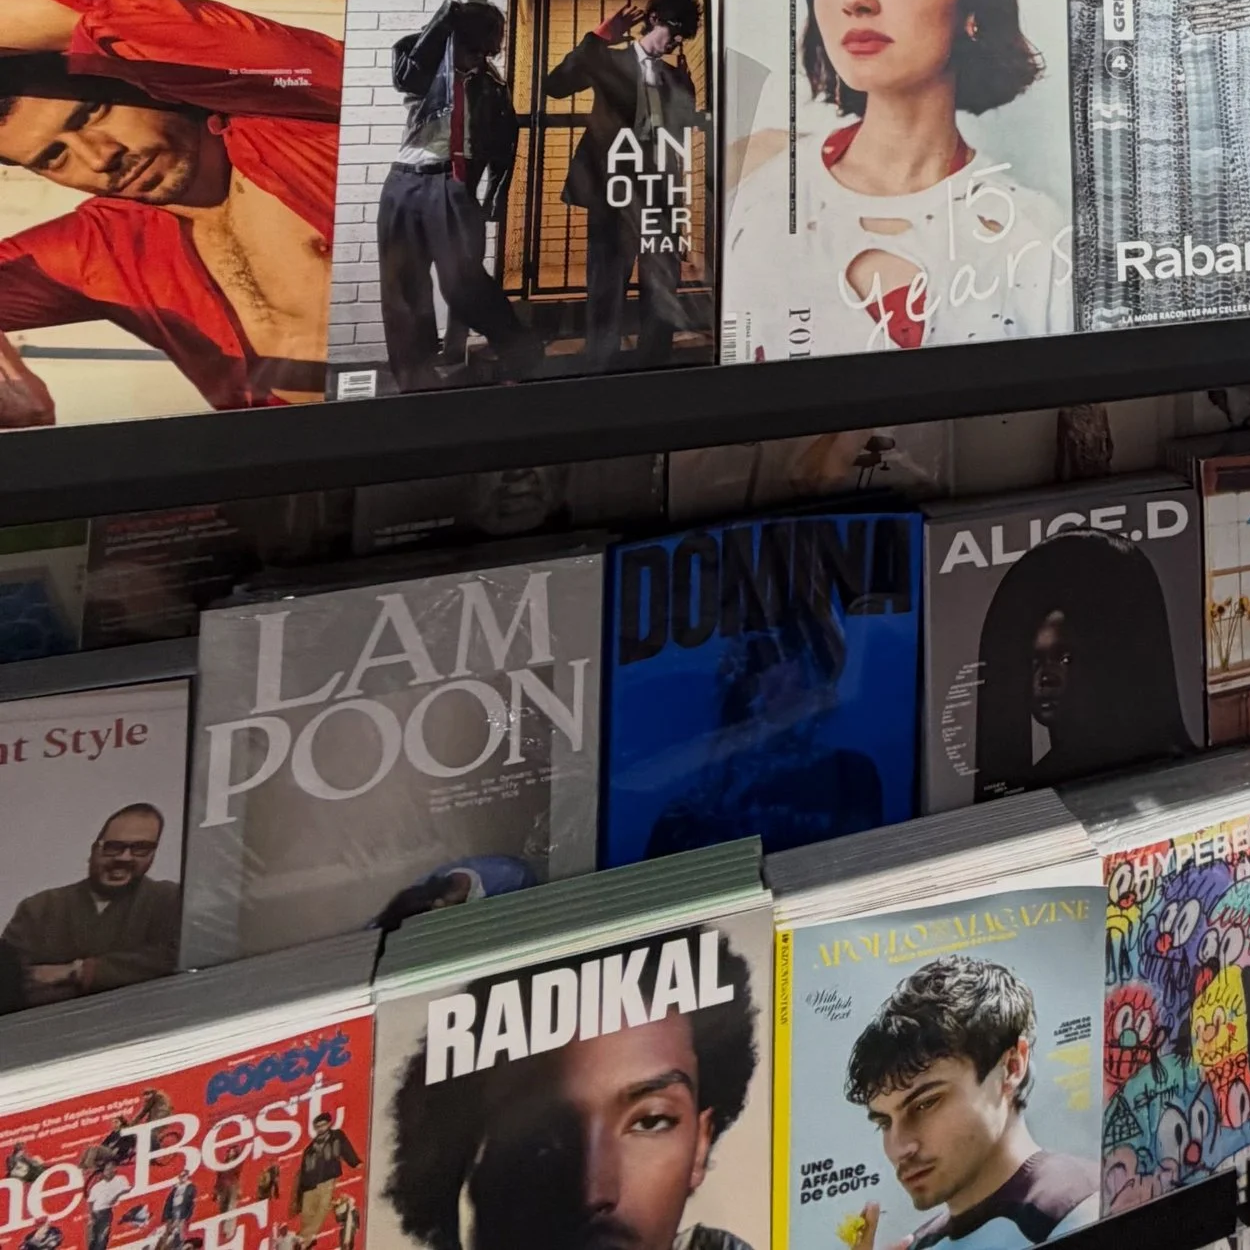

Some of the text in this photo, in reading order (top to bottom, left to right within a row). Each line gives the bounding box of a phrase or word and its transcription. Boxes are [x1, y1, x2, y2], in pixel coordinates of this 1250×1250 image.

[606, 126, 693, 175] AN
[606, 175, 693, 209] OTH
[946, 161, 1015, 261] 15
[641, 208, 693, 235] ER
[641, 235, 692, 254] MAN
[1134, 311, 1158, 323] MODE
[1202, 307, 1218, 316] PAR
[1218, 304, 1248, 315] CELLES
[250, 571, 555, 716] LAM
[43, 717, 148, 761] Style
[200, 658, 591, 828] POON
[425, 930, 735, 1086] RADIKAL
[205, 1034, 351, 1106] POPEYE
[63, 1105, 106, 1122] fashion
[107, 1096, 140, 1111] styles
[119, 1071, 345, 1202] Best
[826, 1170, 880, 1198] GOÛTS
